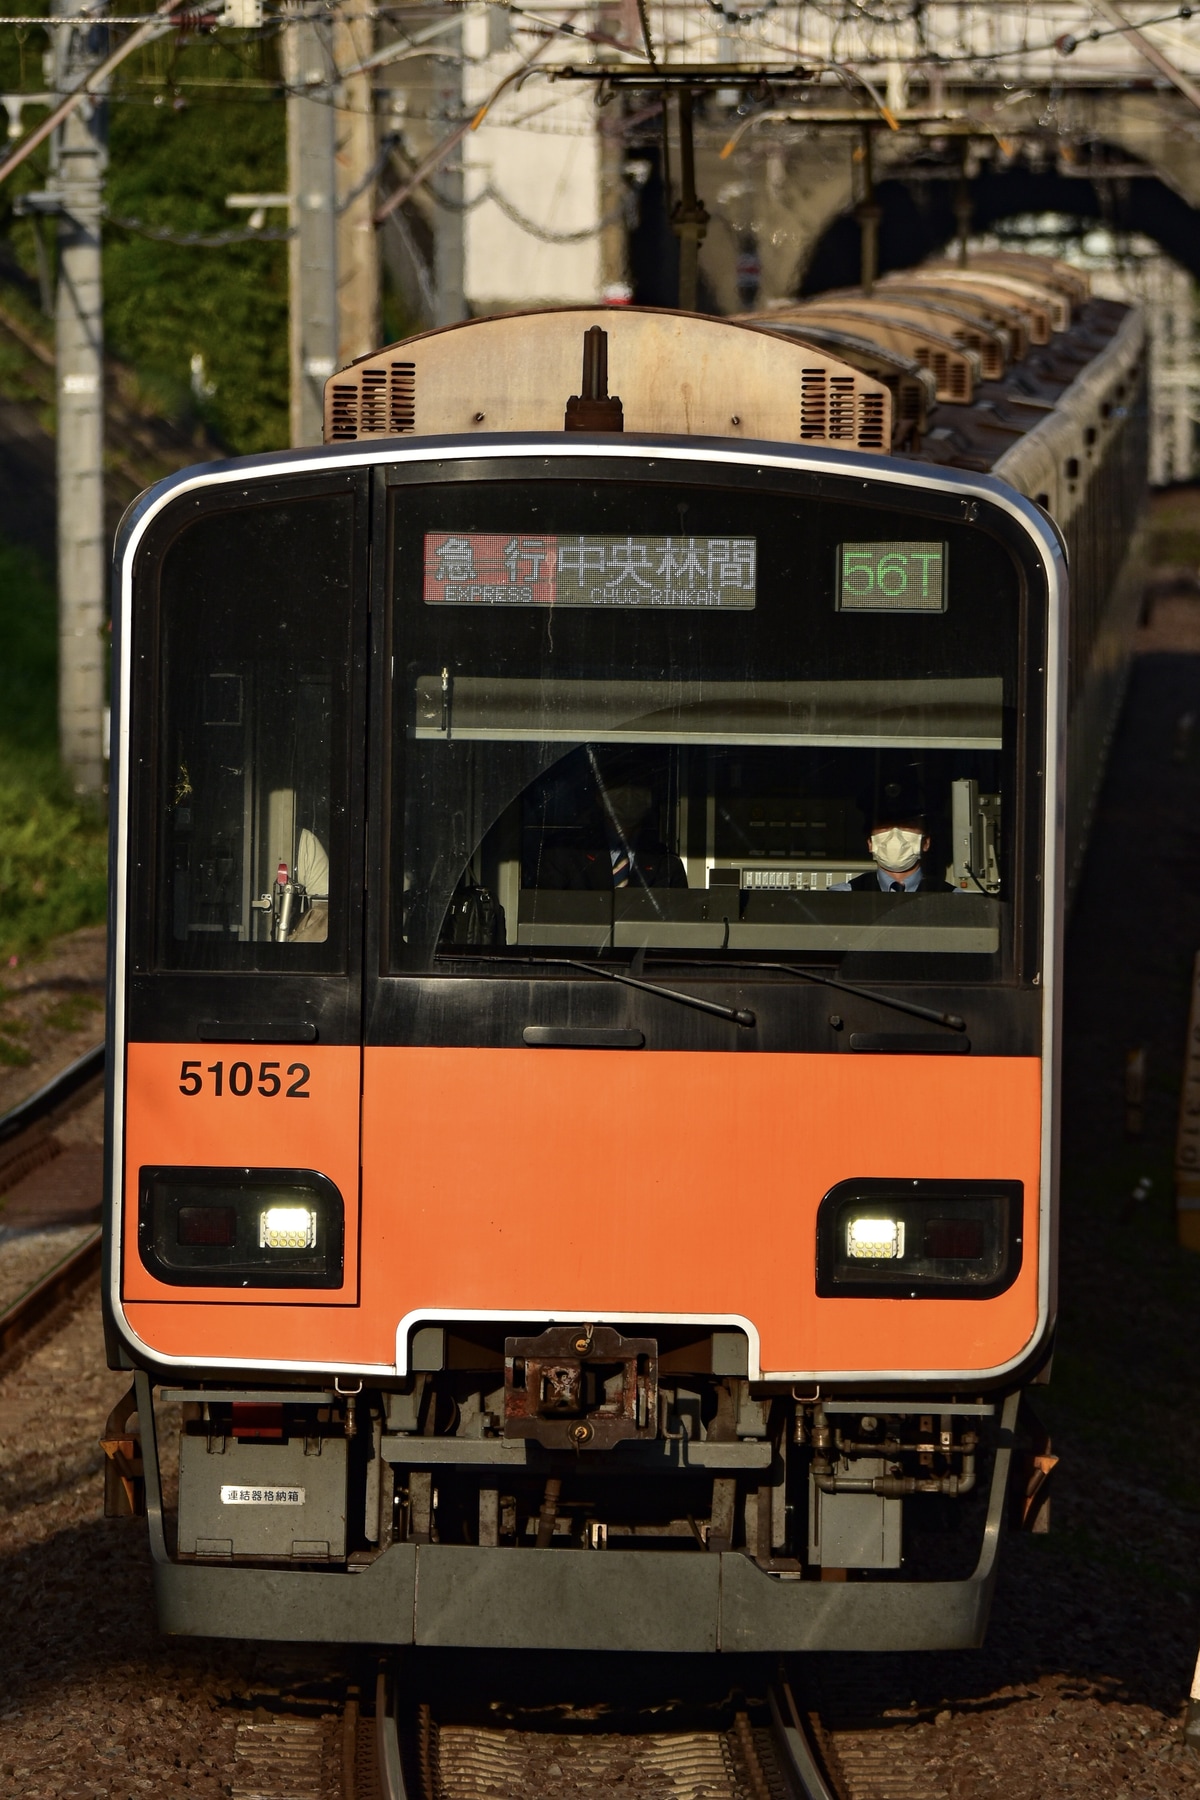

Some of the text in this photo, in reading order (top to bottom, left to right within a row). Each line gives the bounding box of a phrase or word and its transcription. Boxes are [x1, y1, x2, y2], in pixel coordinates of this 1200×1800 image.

[436, 536, 756, 589] 急行 中央林間
[843, 552, 941, 597] 56T
[445, 585, 532, 602] EXPRESS
[179, 1061, 310, 1098] 51052
[227, 1490, 299, 1502] 連結器格納箱
